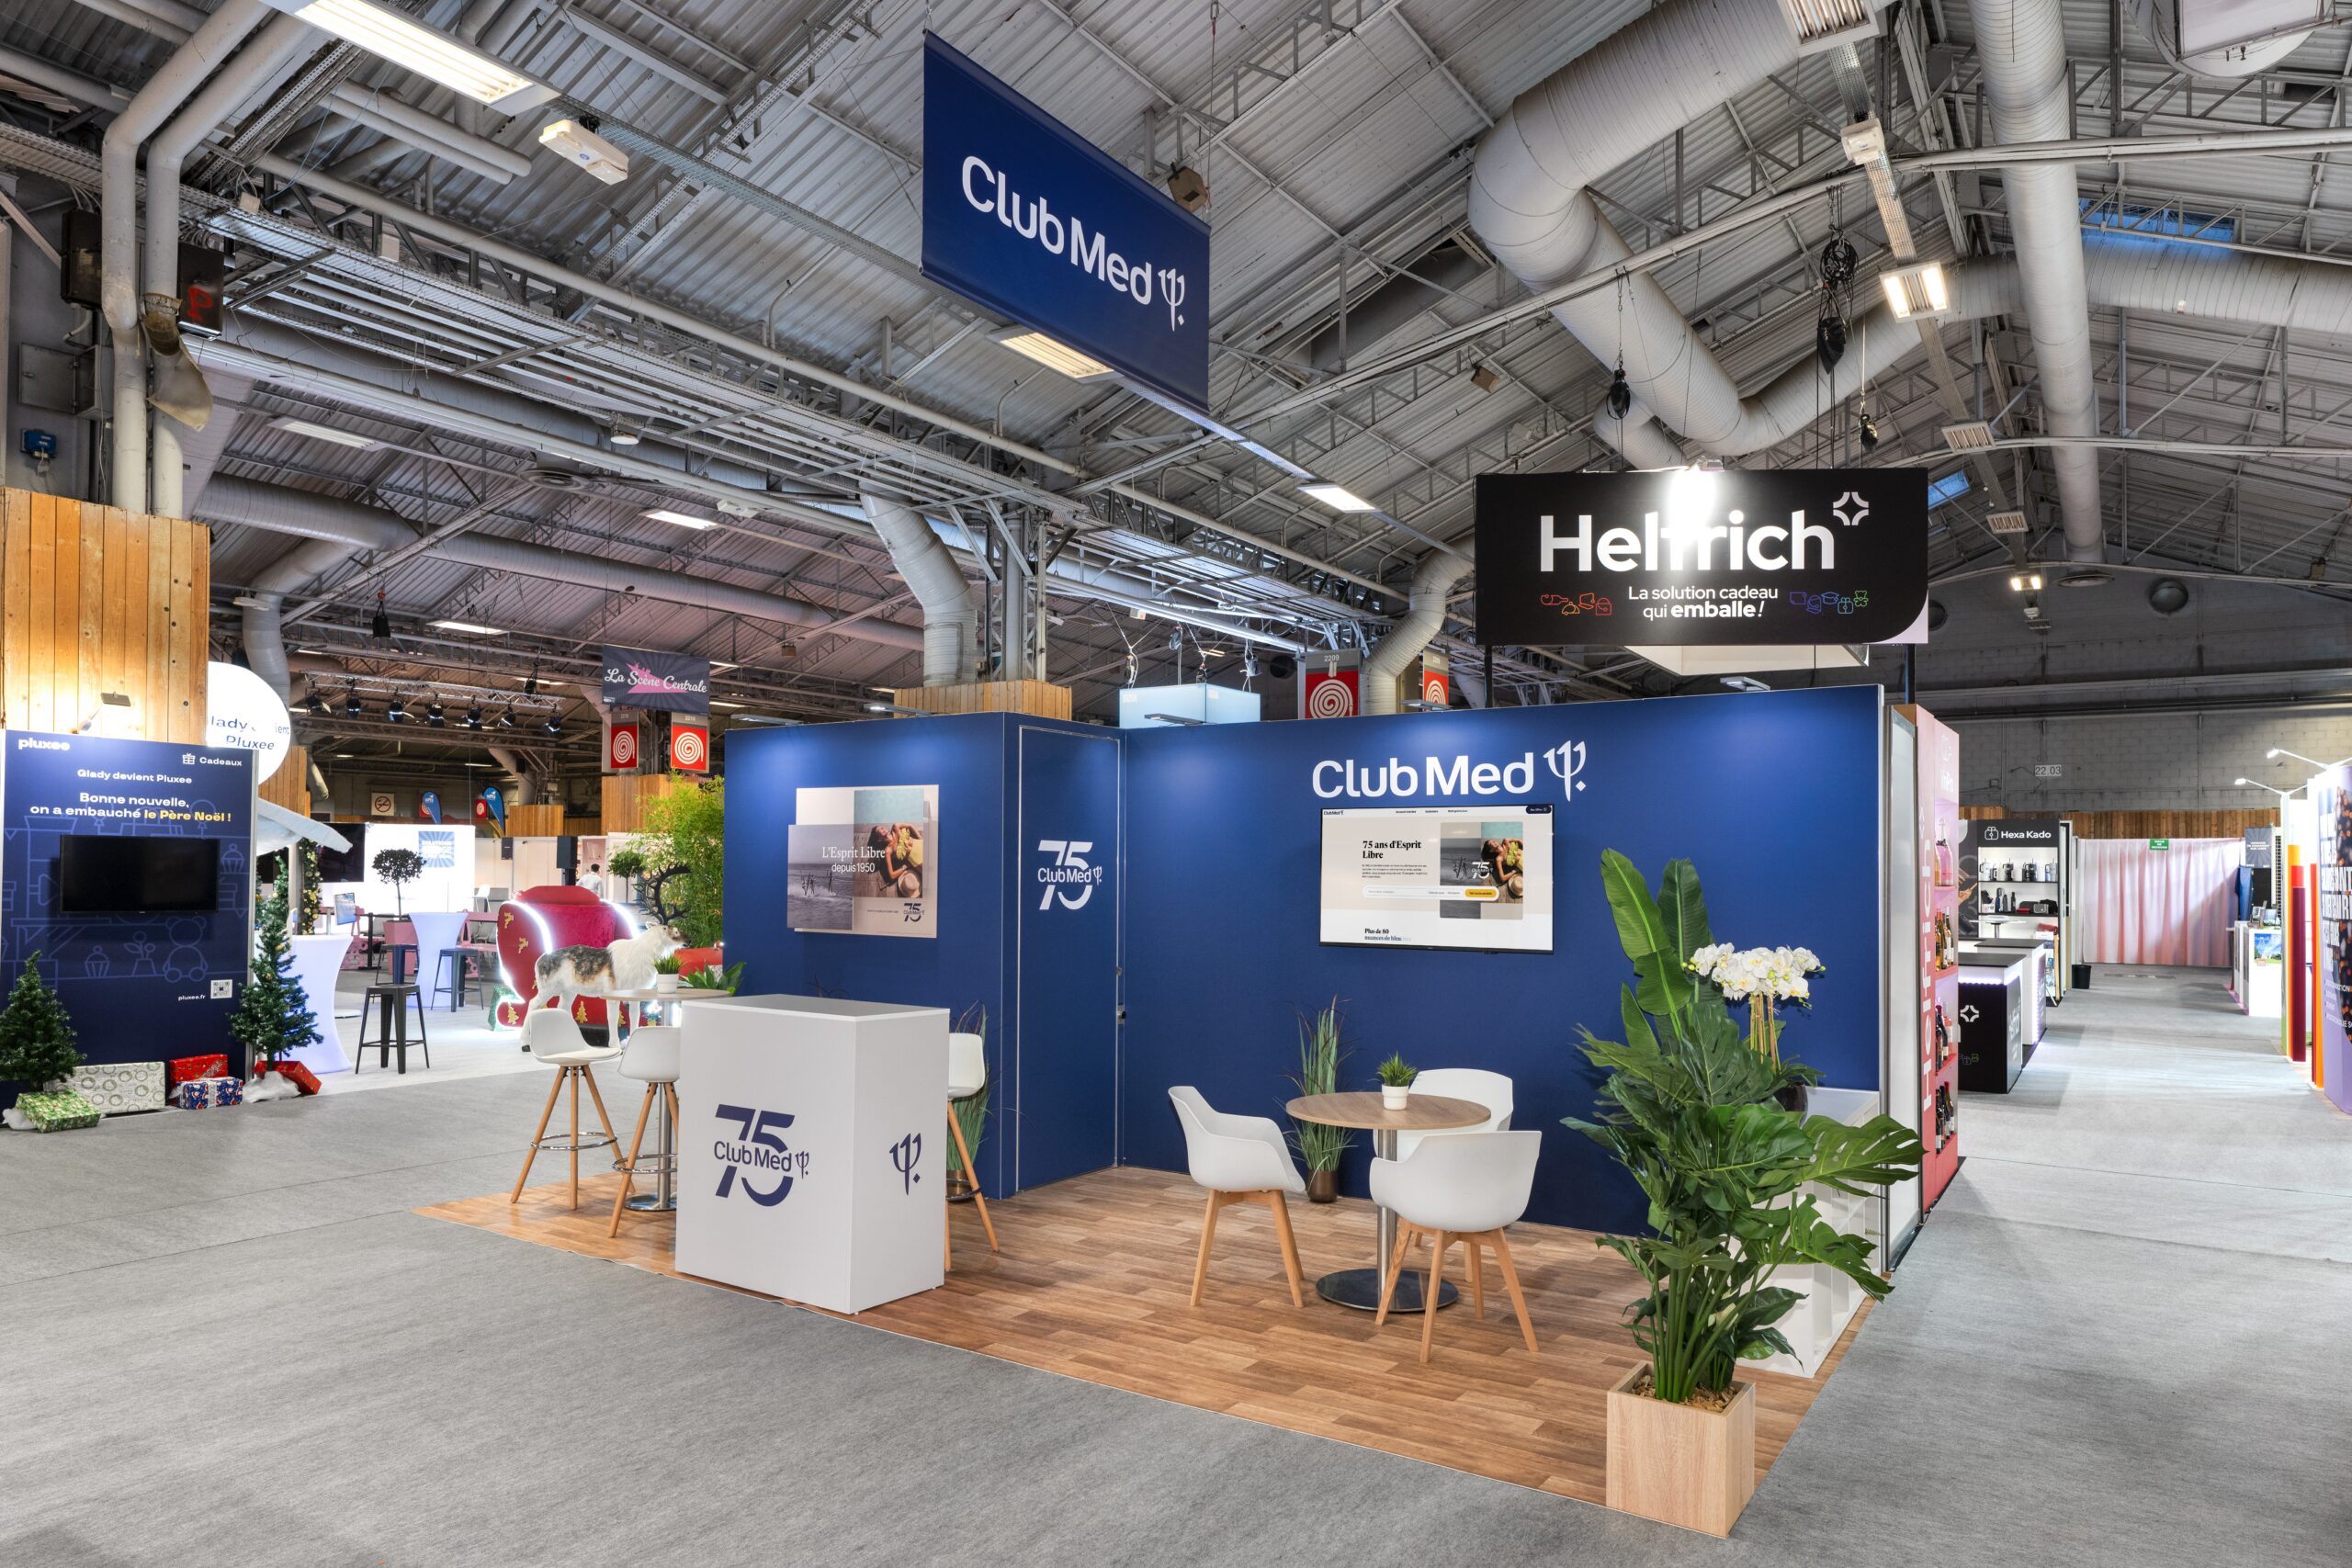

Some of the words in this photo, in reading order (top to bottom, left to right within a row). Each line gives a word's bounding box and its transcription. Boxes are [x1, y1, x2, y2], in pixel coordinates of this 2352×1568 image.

[962, 155, 1065, 254] Club
[1070, 216, 1152, 305] Med
[1540, 508, 1835, 572] Helfrich
[1628, 585, 1649, 601] La
[1652, 585, 1716, 600] solution
[1719, 584, 1779, 600] cadeau
[1643, 604, 1668, 622] qui
[605, 668, 626, 683] La
[628, 671, 662, 687] Scène
[662, 675, 707, 694] Centrale
[210, 716, 248, 733] lady
[17, 737, 71, 751] pluxee
[226, 735, 275, 750] Pluxee
[199, 756, 243, 767] Cadeaux
[77, 769, 110, 781] Glady
[112, 771, 154, 783] devient
[156, 774, 193, 784] Pluxee
[1312, 757, 1419, 798] Club
[1426, 752, 1534, 795] Med
[2035, 766, 2061, 775] 22.03
[80, 792, 126, 805] Bonne
[129, 795, 190, 809] nouvelle,
[30, 806, 50, 815] on
[65, 807, 141, 818] embauché
[144, 809, 156, 818] le
[160, 809, 191, 821] Père
[195, 810, 225, 822] Noël
[2000, 830, 2025, 839] Hexa
[2026, 830, 2052, 839] Kado
[822, 846, 859, 862] L'Esprit
[861, 846, 886, 858] Libre
[1363, 840, 1373, 849] 75
[1389, 840, 1421, 851] d'Esprit
[1363, 851, 1384, 859] Libre
[831, 863, 855, 874] depuis
[857, 863, 876, 873] 1950
[1037, 840, 1093, 910] 75
[1037, 867, 1066, 883] Club
[1066, 868, 1091, 883] Med
[1472, 862, 1489, 879] 75
[904, 903, 922, 922] 75
[714, 1141, 752, 1165] Club
[754, 1147, 792, 1172] Med
[715, 1103, 796, 1207] 75
